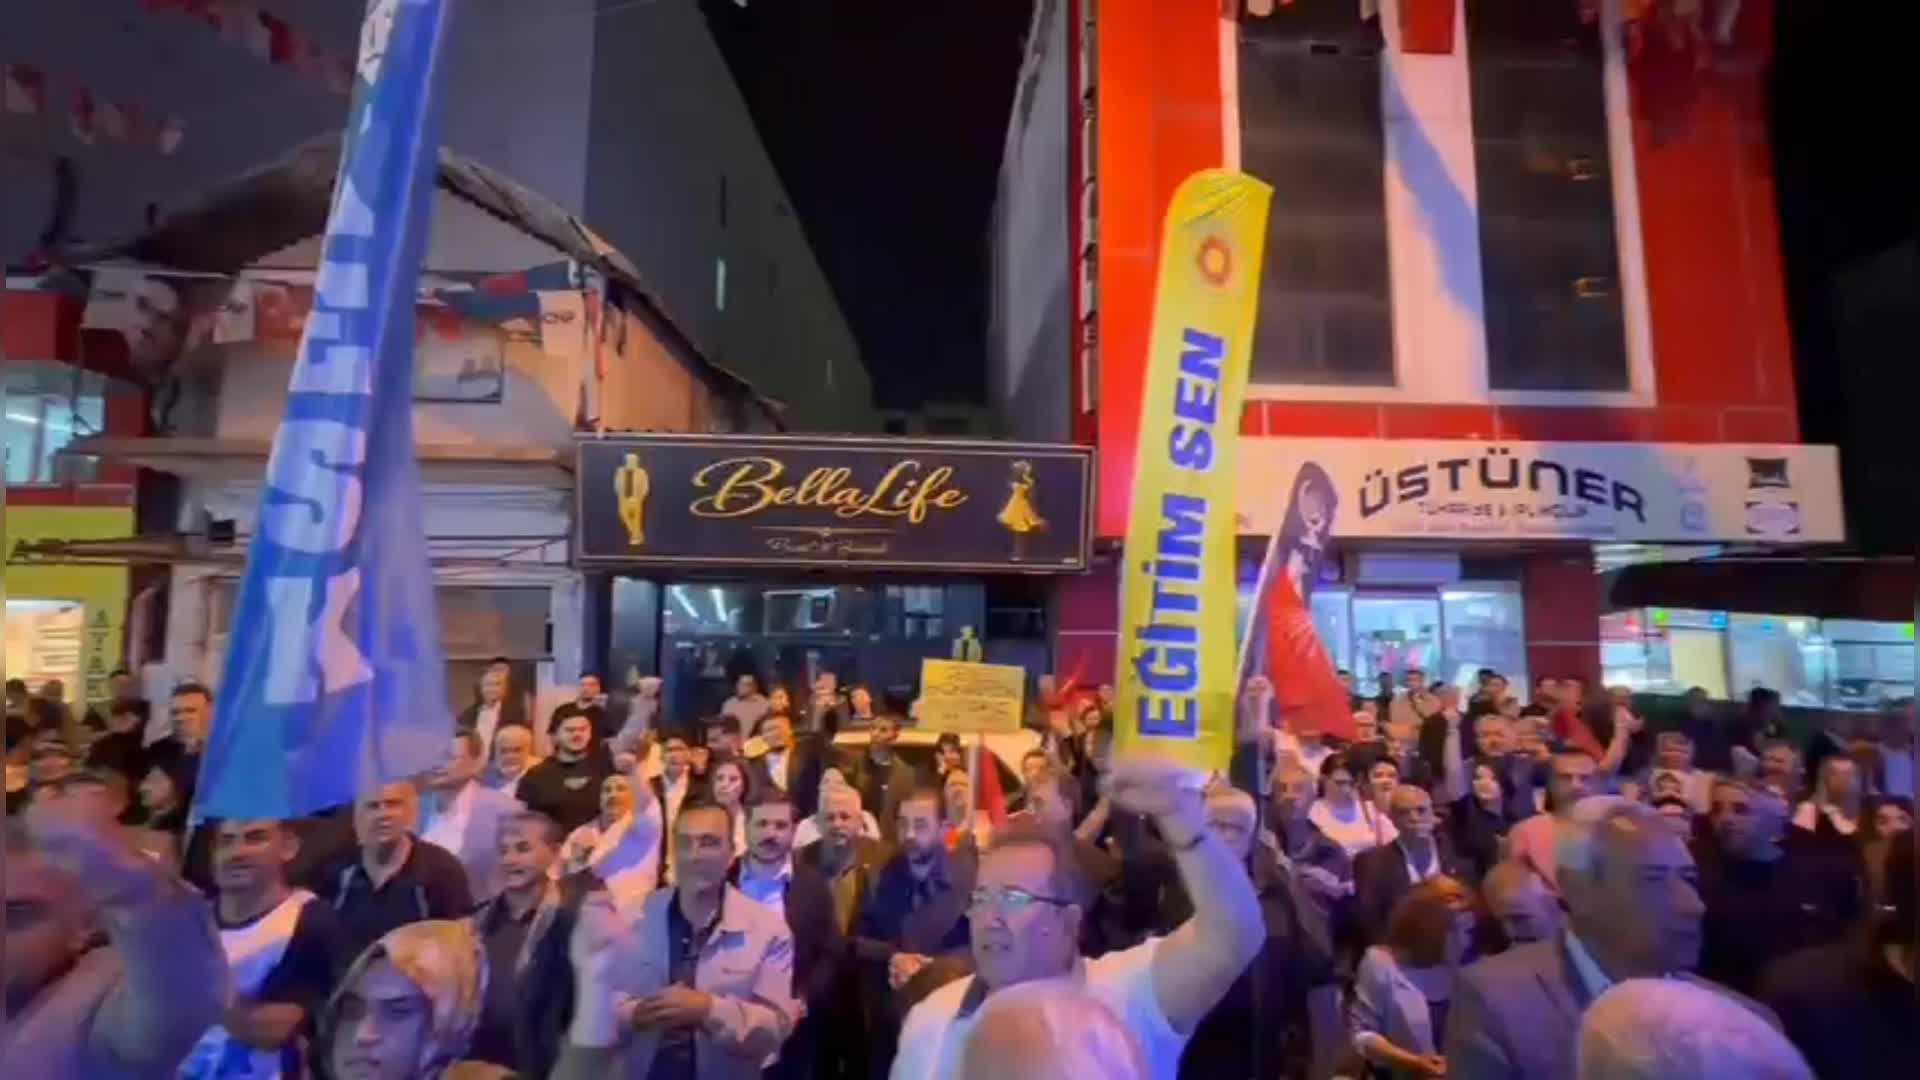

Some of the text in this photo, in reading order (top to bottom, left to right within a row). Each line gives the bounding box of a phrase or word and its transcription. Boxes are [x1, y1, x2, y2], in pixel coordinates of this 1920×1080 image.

[1131, 327, 1225, 738] EĞİTİM SEN
[1359, 447, 1647, 524] ÜSTÜNER
